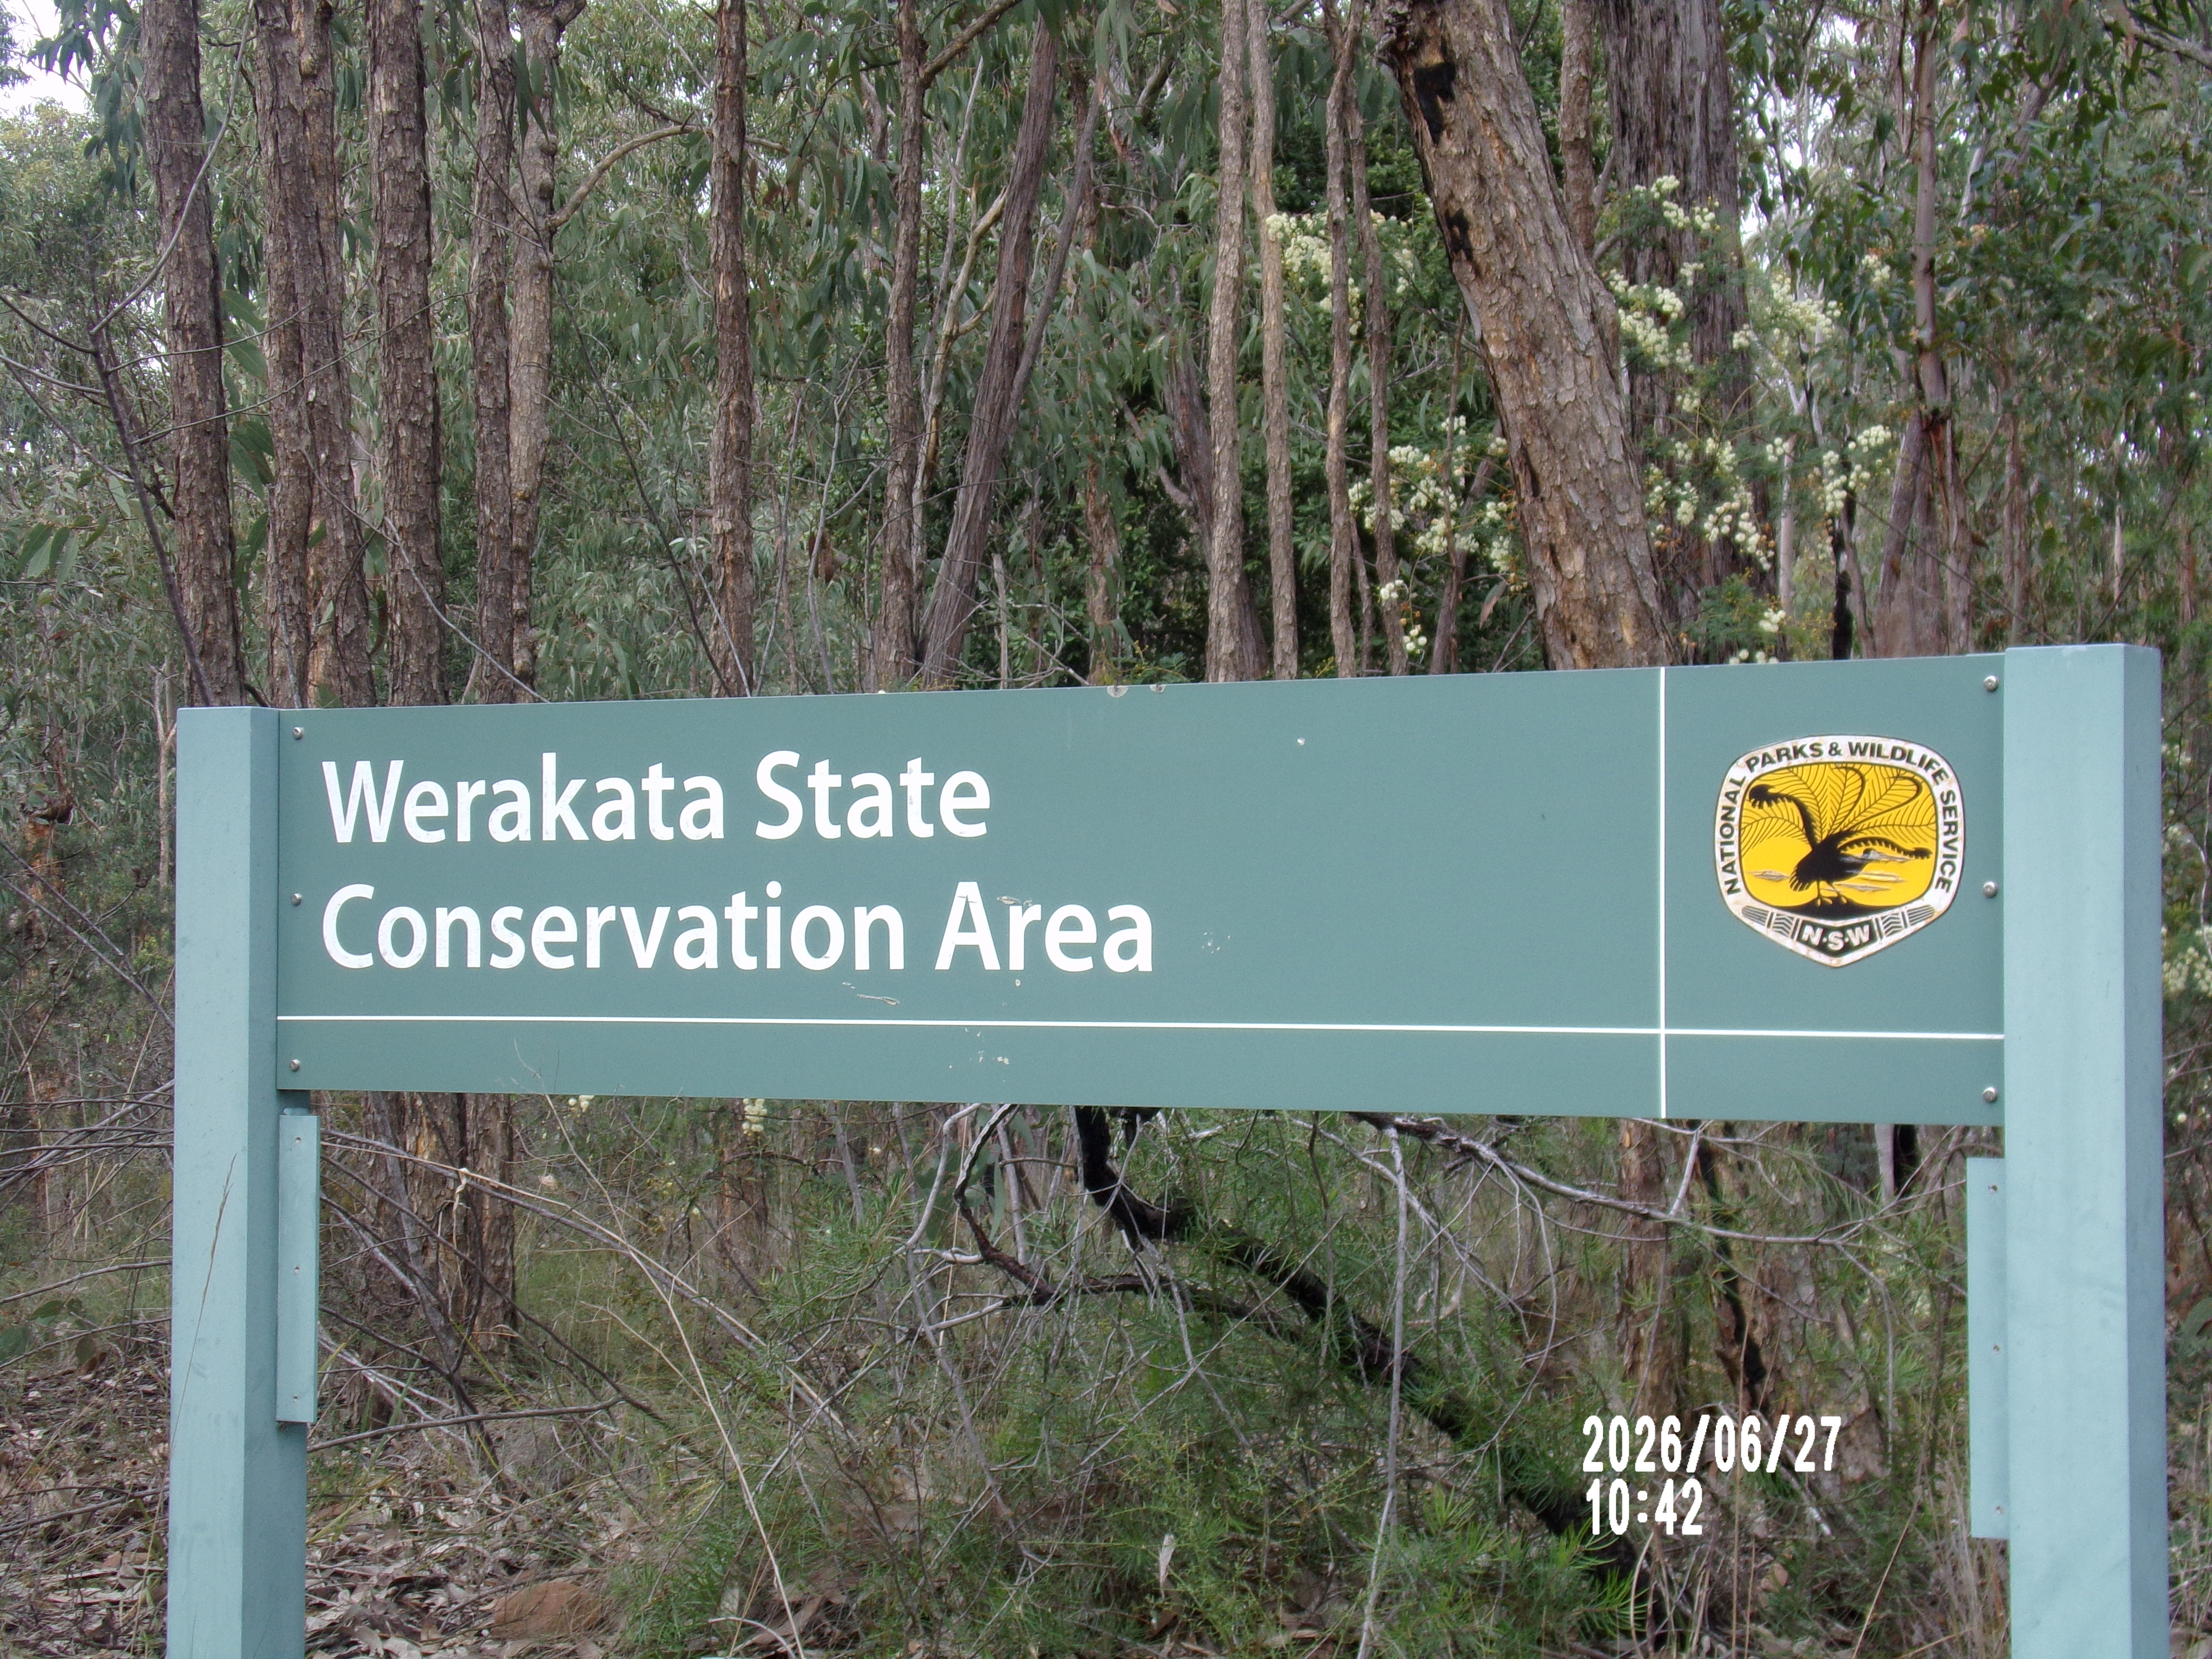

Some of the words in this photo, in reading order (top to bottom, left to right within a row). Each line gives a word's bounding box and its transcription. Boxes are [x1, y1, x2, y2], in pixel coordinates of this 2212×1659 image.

[322, 752, 724, 843] Werakata
[756, 750, 990, 840] State
[1719, 774, 1747, 895] NATIONAL
[1745, 742, 1824, 773] PARKS
[1828, 741, 1843, 756] &
[1848, 741, 1950, 786] WILDLIFE
[1935, 789, 1958, 893] SERVICE
[323, 881, 904, 971] Conservation
[935, 881, 1153, 973] Area
